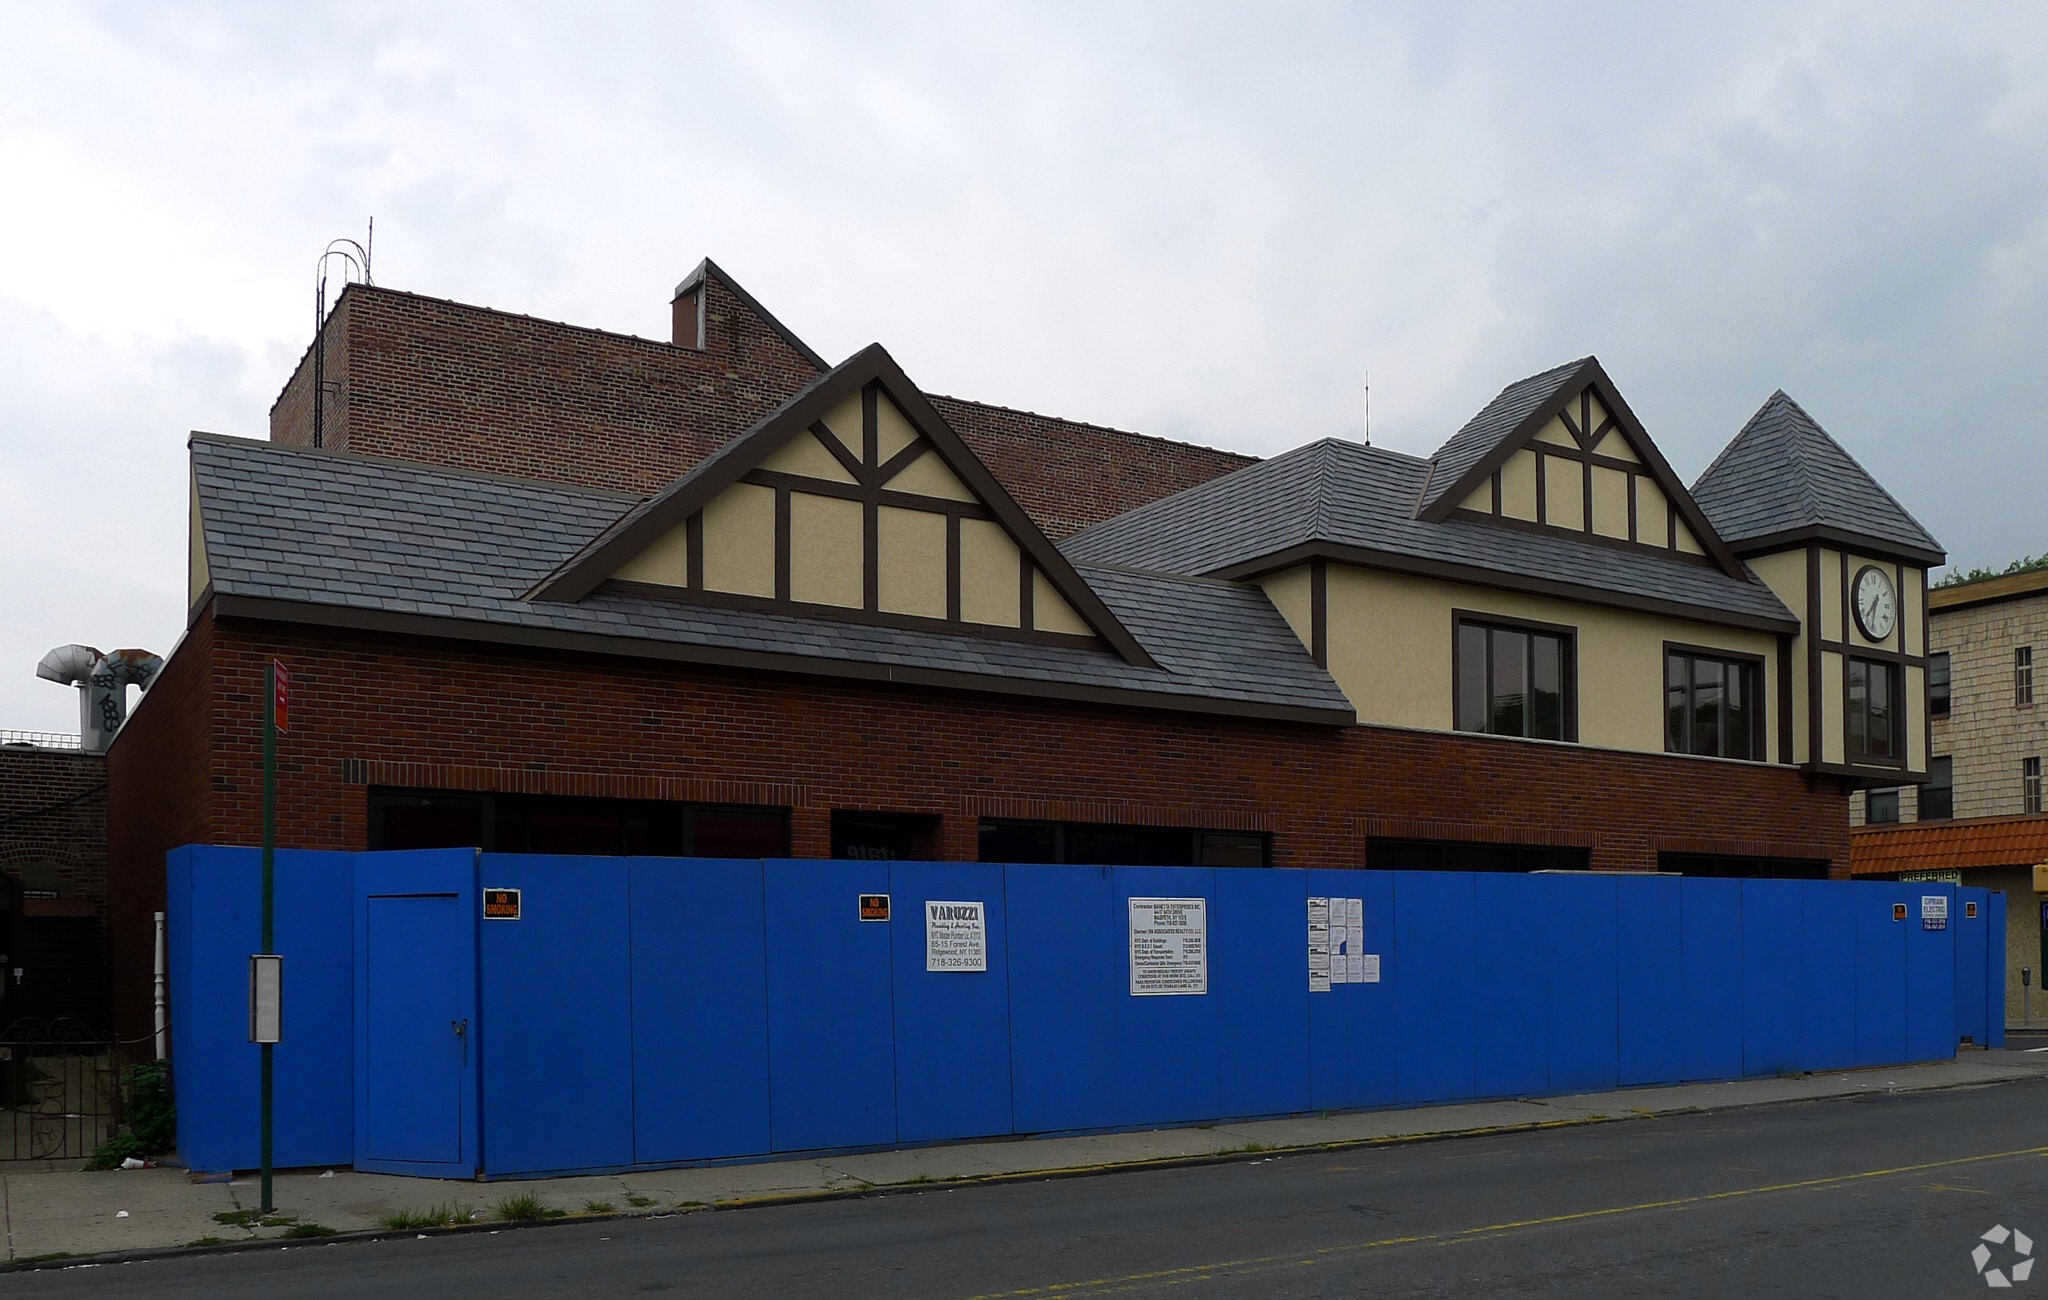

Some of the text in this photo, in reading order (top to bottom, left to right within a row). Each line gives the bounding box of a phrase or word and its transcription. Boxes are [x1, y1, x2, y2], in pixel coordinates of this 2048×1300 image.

[1901, 871, 1957, 882] PREFERRED
[496, 893, 507, 904] NO
[870, 898, 879, 907] NO
[486, 904, 518, 915] SMOKING
[862, 907, 887, 917] SMOKING
[930, 905, 979, 920] VARUZZI
[931, 921, 950, 930] Plumbing
[931, 940, 949, 948] 65-15
[949, 940, 968, 948] Forest
[959, 948, 967, 956] NY
[931, 957, 982, 967] 718-326-9300
